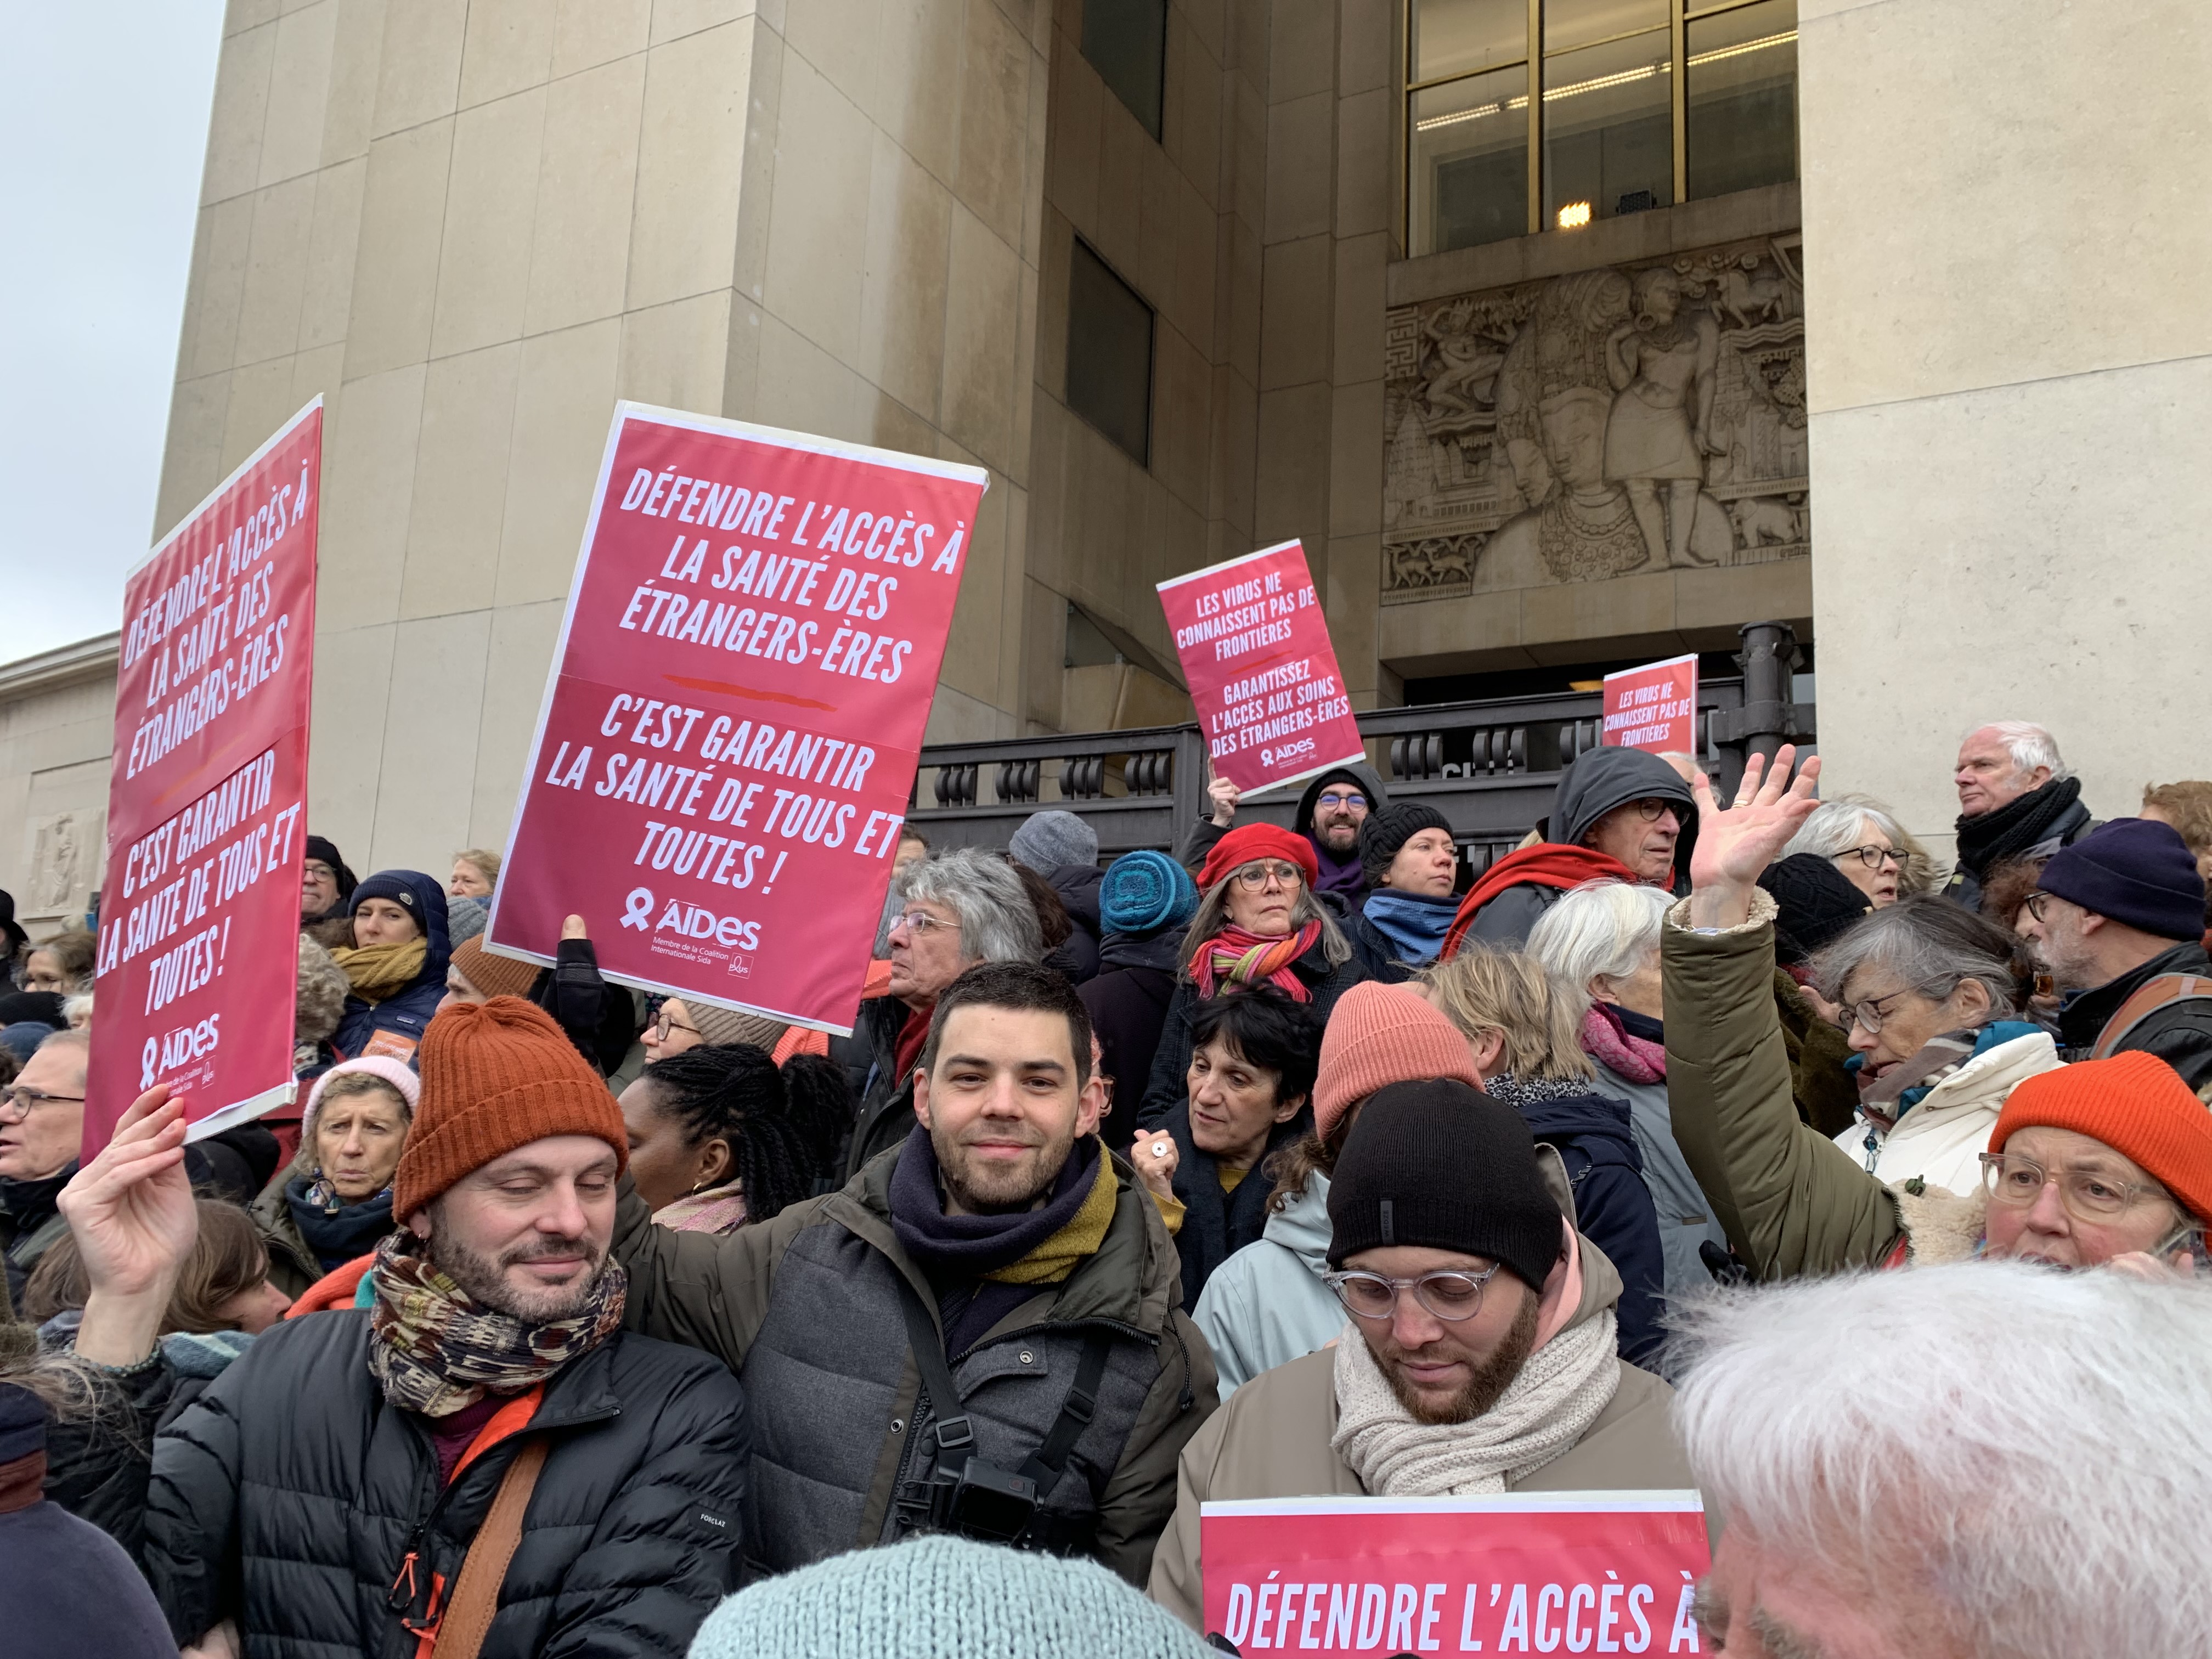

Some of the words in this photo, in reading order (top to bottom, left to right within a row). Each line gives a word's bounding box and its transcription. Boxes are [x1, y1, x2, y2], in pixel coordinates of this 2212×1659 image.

[620, 465, 795, 540] DÉFENDRE
[930, 520, 964, 575] À
[124, 552, 213, 669] DÉFENDRE
[291, 458, 308, 528] À
[660, 535, 709, 584] LA
[711, 545, 831, 607] SANTÉ
[823, 567, 898, 620] DES
[1196, 592, 1220, 618] LES
[1222, 578, 1262, 608] VIRUS
[1265, 571, 1282, 595] NE
[146, 647, 170, 708] LA
[173, 583, 234, 687] SANTÉ
[234, 560, 274, 639] DES
[619, 579, 912, 684] ÉTRANGERS-ÈRES
[1177, 601, 1266, 649] CONNAISSENT
[1269, 592, 1295, 618] PAS
[1298, 585, 1315, 608] DE
[1215, 618, 1291, 661] FRONTIÈRES
[126, 614, 289, 781] ÉTRANGERS-ÈRES
[1212, 698, 1264, 733] L'ACCÈS
[1268, 689, 1294, 715] AUX
[1297, 675, 1335, 706] SOINS
[1223, 658, 1311, 705] GARANTISSEZ
[1604, 704, 1658, 732] CONNAISSENT
[1658, 701, 1678, 720] PAS
[1678, 697, 1691, 717] DE
[1618, 690, 1634, 709] LES
[1635, 684, 1660, 705] VIRUS
[1660, 681, 1674, 700] NE
[700, 715, 875, 792] GARANTIR
[1211, 733, 1237, 759] DES
[1240, 695, 1349, 749] ÉTRANGERS-ÈRES
[1621, 723, 1671, 747] FRONTIÈRES
[123, 817, 177, 899] C'EST
[176, 749, 274, 865] GARANTIR
[545, 741, 593, 791] LA
[595, 753, 716, 816] SANTÉ
[708, 777, 765, 828] DE
[763, 788, 856, 848] TOUS
[853, 810, 904, 859] ET
[97, 917, 121, 979] LA
[122, 865, 187, 963] SANTÉ
[183, 857, 213, 927] DE
[215, 822, 267, 907] TOUS
[266, 801, 301, 873] ET
[634, 821, 765, 889] TOUTES
[761, 851, 788, 894] !
[145, 924, 218, 1016] TOUTES
[217, 916, 231, 977] !
[651, 944, 696, 961] Internationale
[697, 955, 712, 965] Sida
[653, 936, 681, 949] Membre
[681, 943, 691, 951] de
[699, 947, 729, 961] Coalition
[700, 1514, 726, 1527] FORCLAZ
[1224, 1570, 1448, 1651] DÉFENDRE
[1668, 1570, 1700, 1654] À
